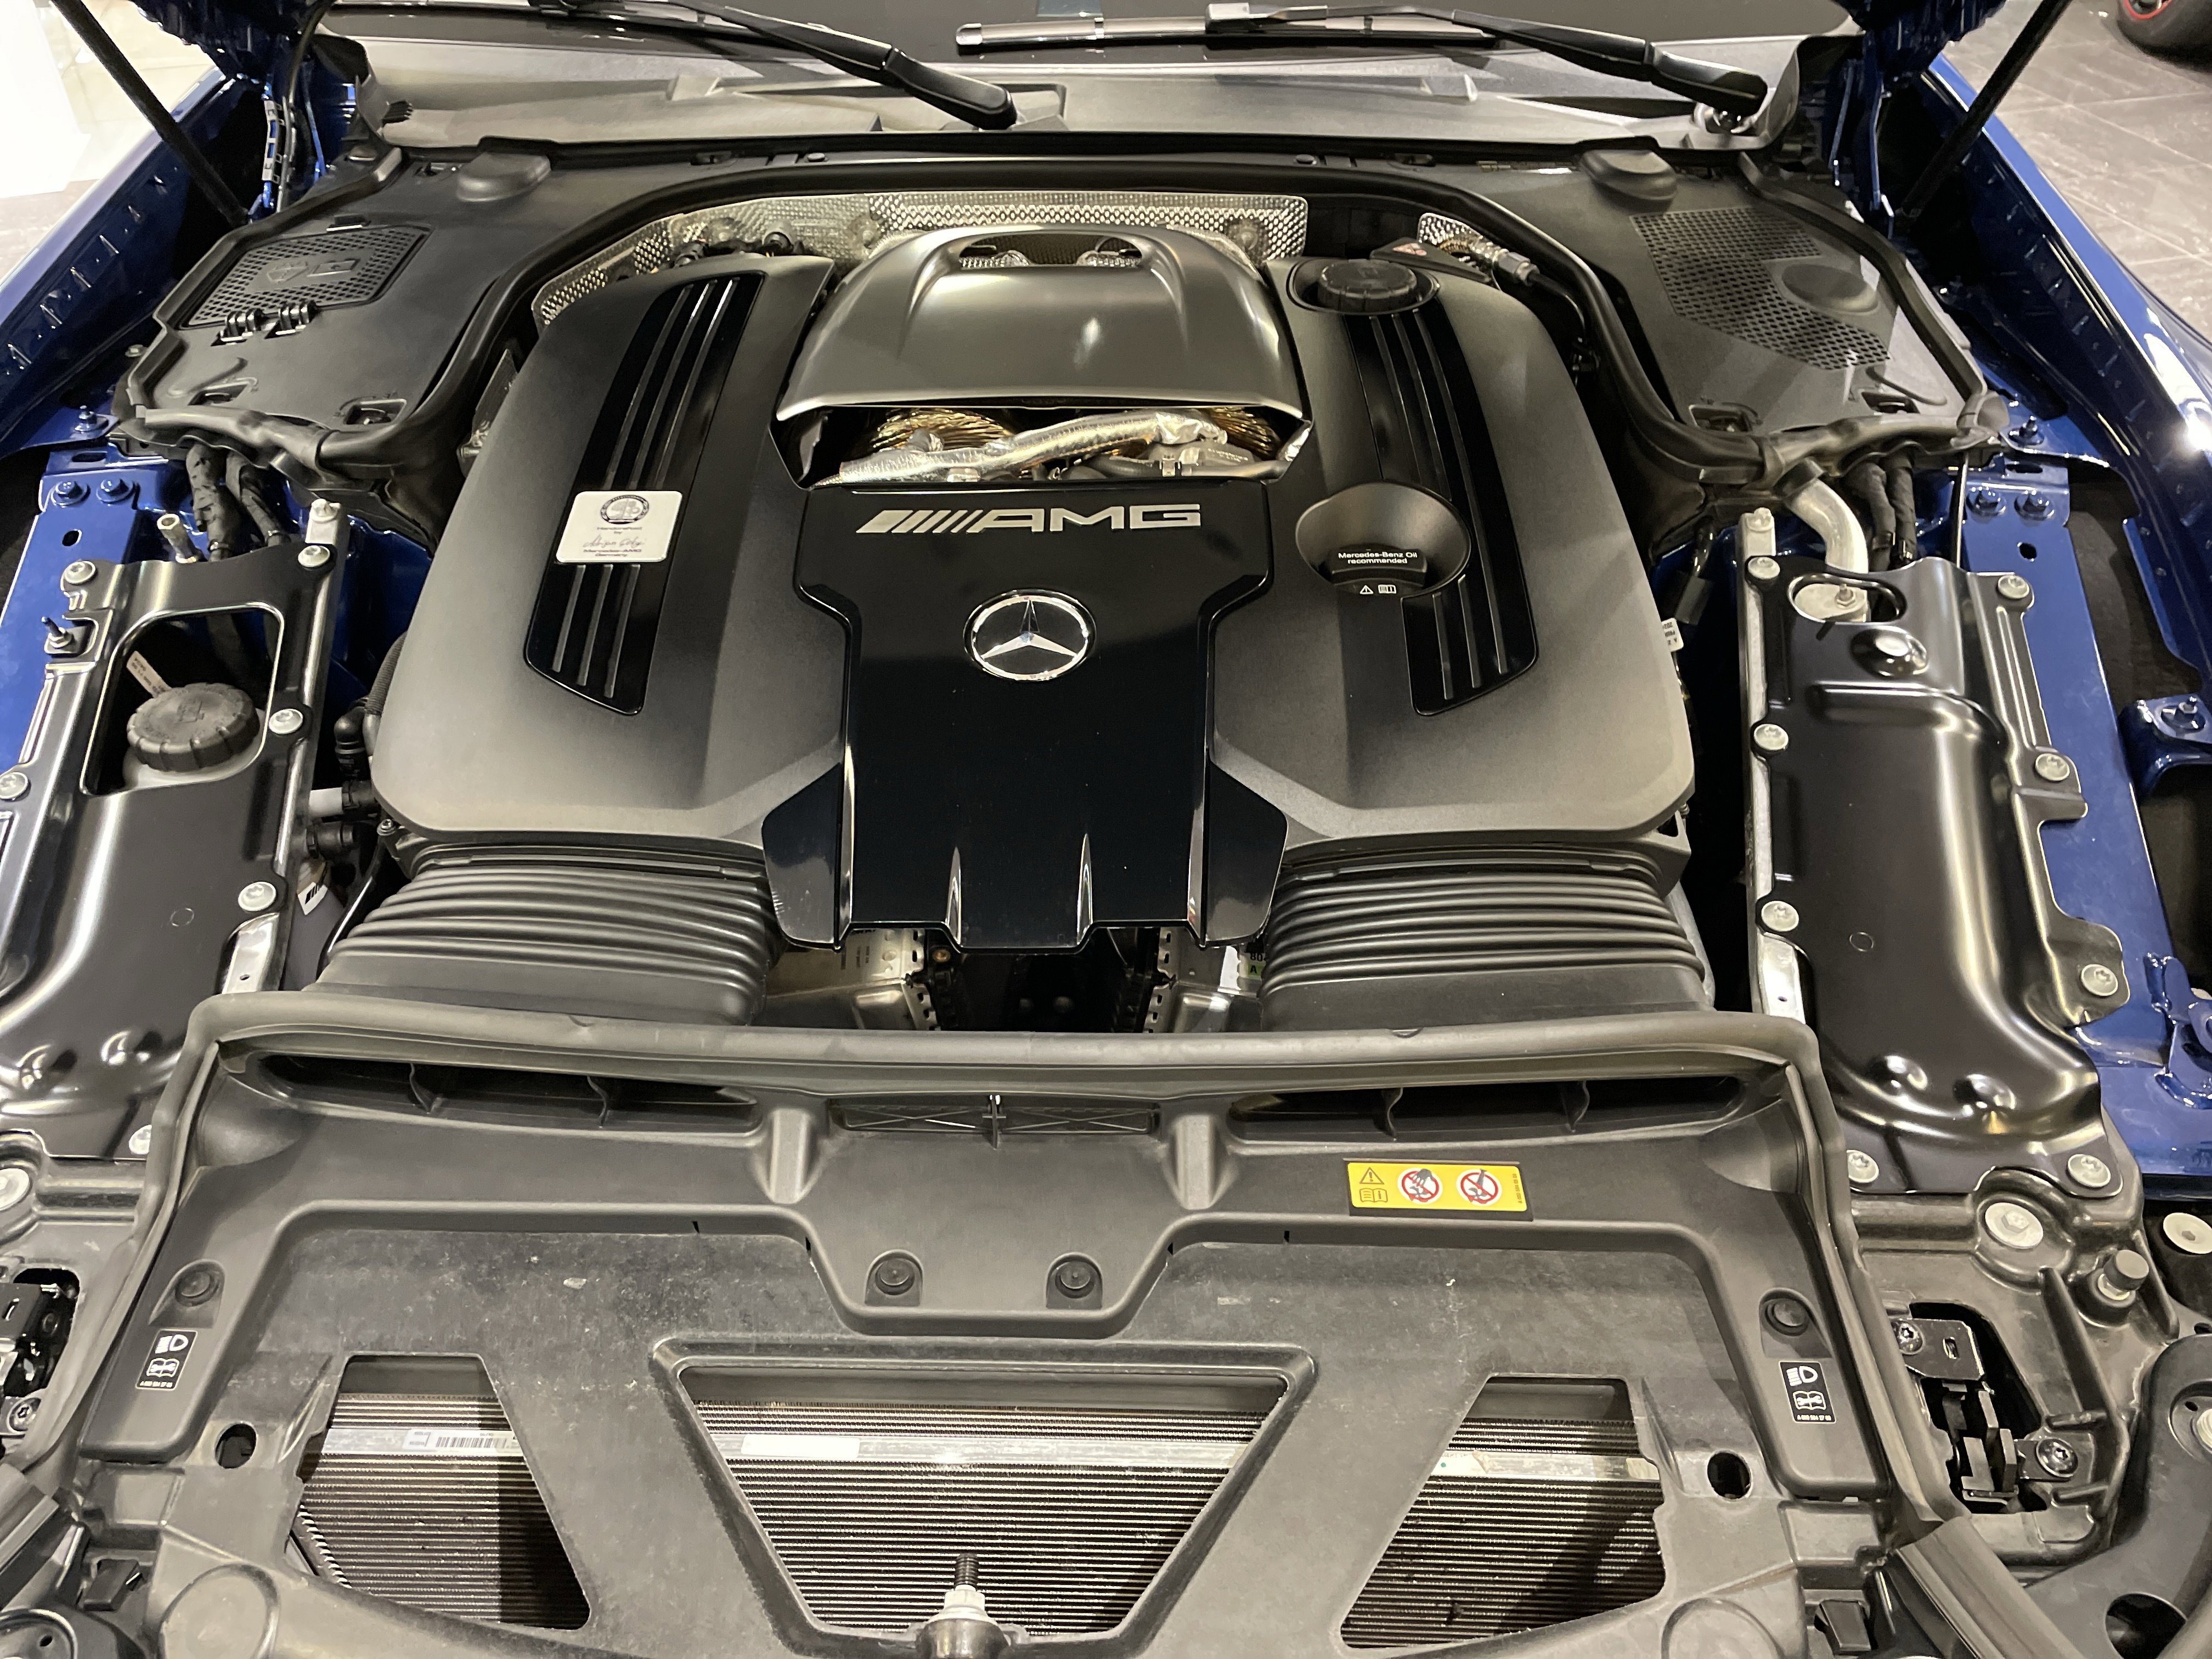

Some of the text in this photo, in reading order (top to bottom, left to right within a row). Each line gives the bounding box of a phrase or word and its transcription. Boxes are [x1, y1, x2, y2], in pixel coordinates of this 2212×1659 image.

[966, 504, 1201, 533] AMG
[1250, 952, 1266, 962] 80
[1250, 965, 1257, 974] A
